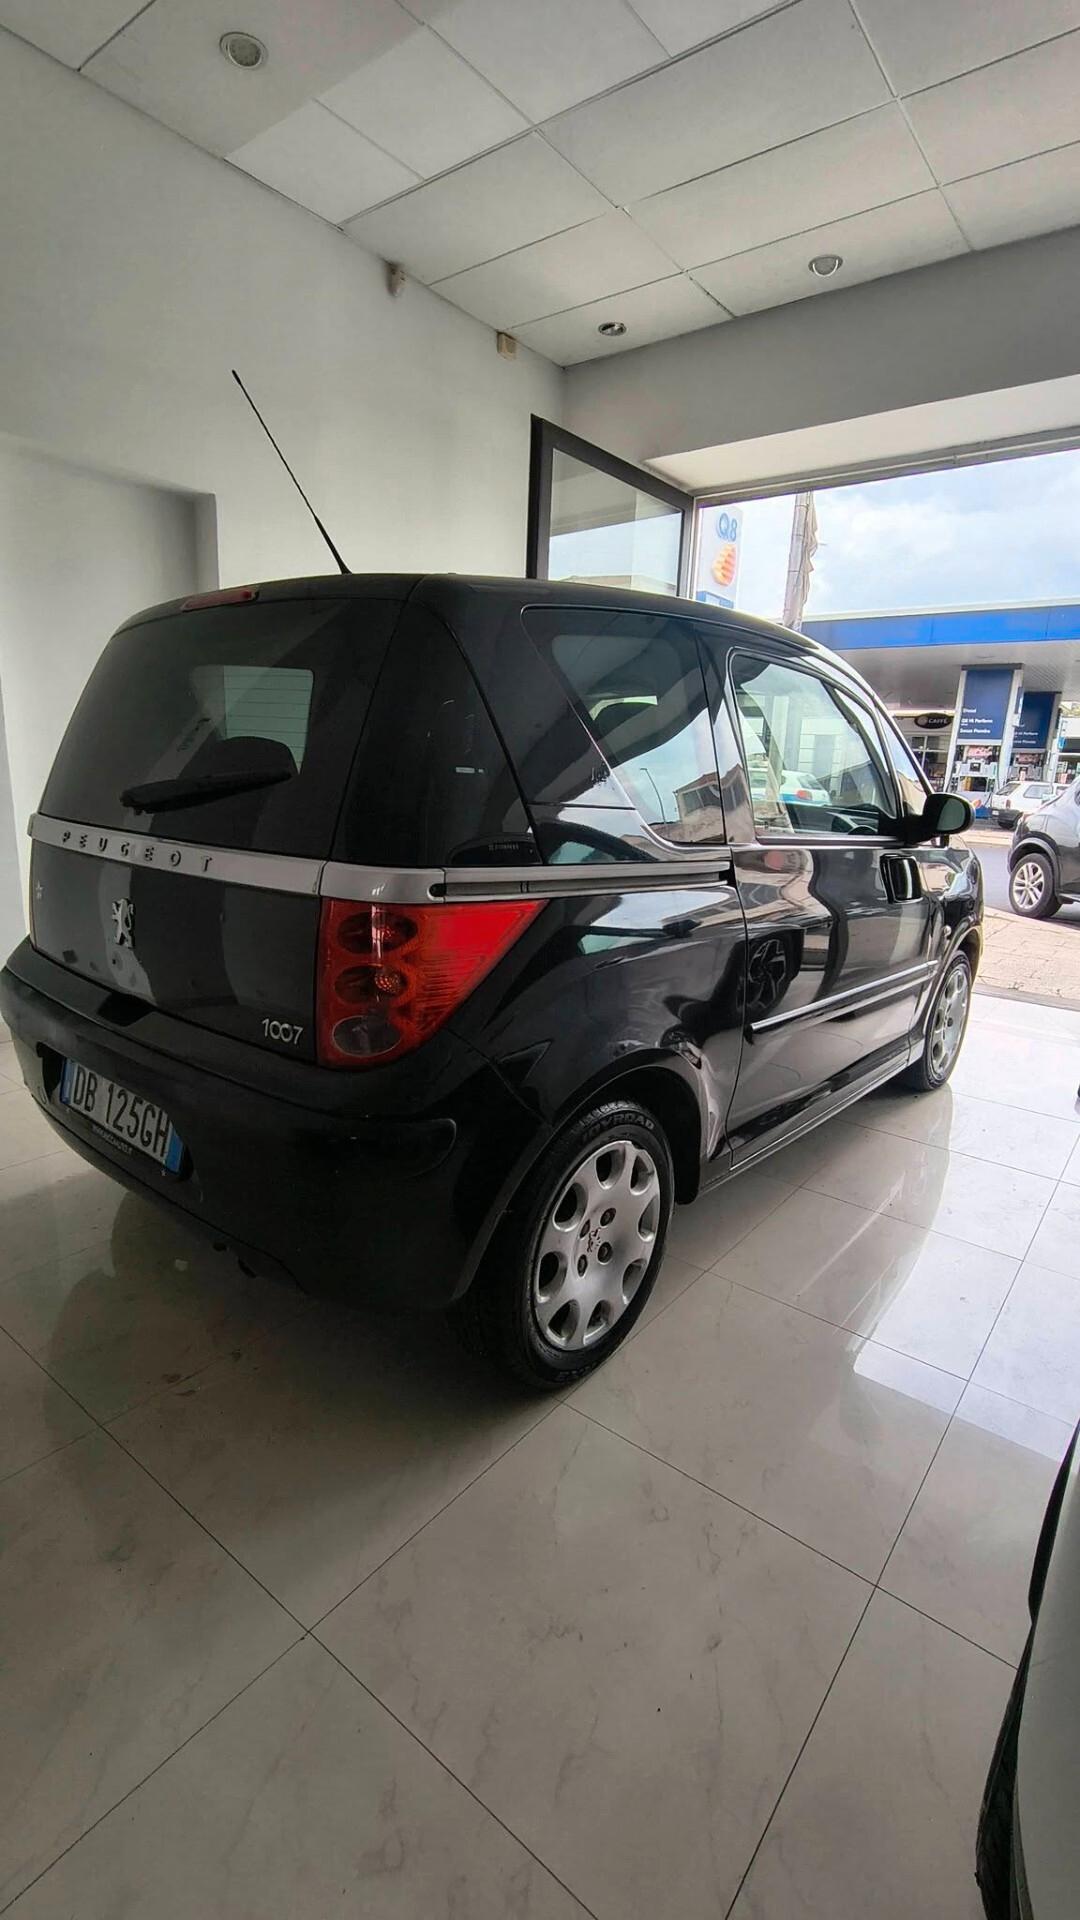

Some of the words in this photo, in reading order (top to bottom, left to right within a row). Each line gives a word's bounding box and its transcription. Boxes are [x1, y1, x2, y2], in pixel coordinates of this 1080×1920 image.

[716, 512, 737, 542] Q8
[61, 830, 213, 873] PEUGEOT
[261, 1018, 304, 1045] 1007
[73, 1065, 98, 1113] DB
[106, 1083, 171, 1158] 125GH
